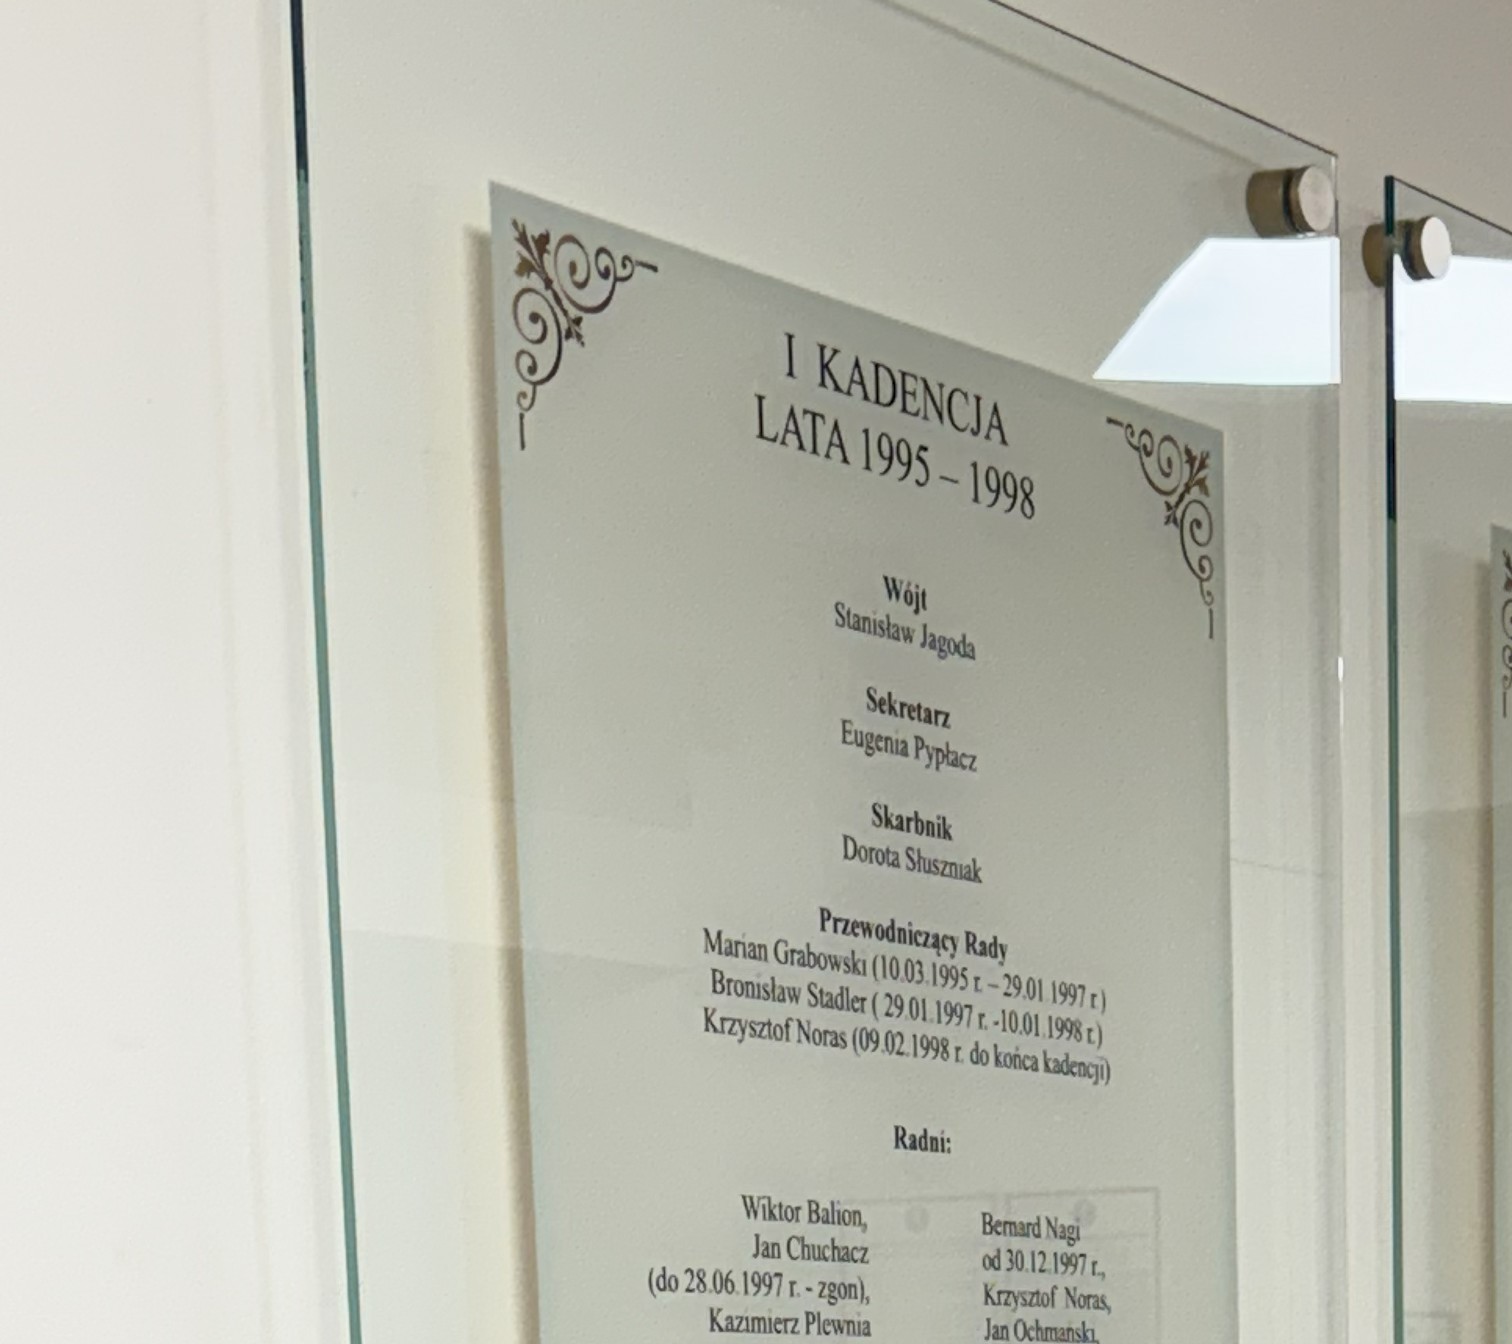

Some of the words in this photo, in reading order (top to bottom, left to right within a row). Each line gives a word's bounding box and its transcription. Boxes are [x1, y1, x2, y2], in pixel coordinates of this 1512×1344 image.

[783, 332, 797, 380] I
[816, 342, 1009, 447] KADENCJA
[753, 393, 851, 466] LATA
[861, 427, 930, 488] 1995
[970, 460, 1035, 520] 1998
[882, 574, 927, 616] Wójt
[833, 601, 915, 644] Stanisław
[919, 622, 976, 661] Jagoda
[866, 686, 951, 729] Sekretarz
[841, 718, 909, 758] Eugenia
[913, 734, 977, 773] Pypłacz
[870, 802, 953, 841] Skarbnik
[842, 833, 901, 869] Dorota
[904, 846, 983, 884] Słuszniak
[818, 906, 959, 960] Przewodniczący
[963, 930, 1008, 967] Rady
[702, 927, 769, 963] Marian
[773, 938, 867, 977] Grabowski
[871, 954, 969, 991] (10.03.1995
[1002, 973, 1086, 1008] 29.01.1997
[710, 967, 802, 1005] Bronisław
[806, 981, 868, 1014] Stadler
[883, 991, 973, 1028] 29.01.1997
[703, 1006, 794, 1044] Krzysztof
[795, 1018, 848, 1050] Noras
[851, 1026, 950, 1062] (09.02.1998
[969, 1040, 990, 1067] do
[992, 1043, 1040, 1073] końca
[1042, 1049, 1111, 1086] kadencji)
[893, 1124, 951, 1154] Radni:
[740, 1194, 802, 1223] Wiktor
[806, 1199, 868, 1233] Balion,
[980, 1211, 1042, 1239] Bernard
[751, 1233, 782, 1260] Jan
[785, 1235, 869, 1265] Chuchacz
[981, 1247, 1001, 1272] od
[647, 1266, 679, 1299] (do
[683, 1267, 784, 1297] 28.06.1997
[817, 1276, 870, 1306] zgon),
[982, 1282, 1058, 1312] Krzysztof
[1063, 1286, 1111, 1314] Noras,
[709, 1306, 800, 1335] Kazimierz
[803, 1310, 872, 1337] Plewnia
[983, 1317, 1010, 1342] Jan
